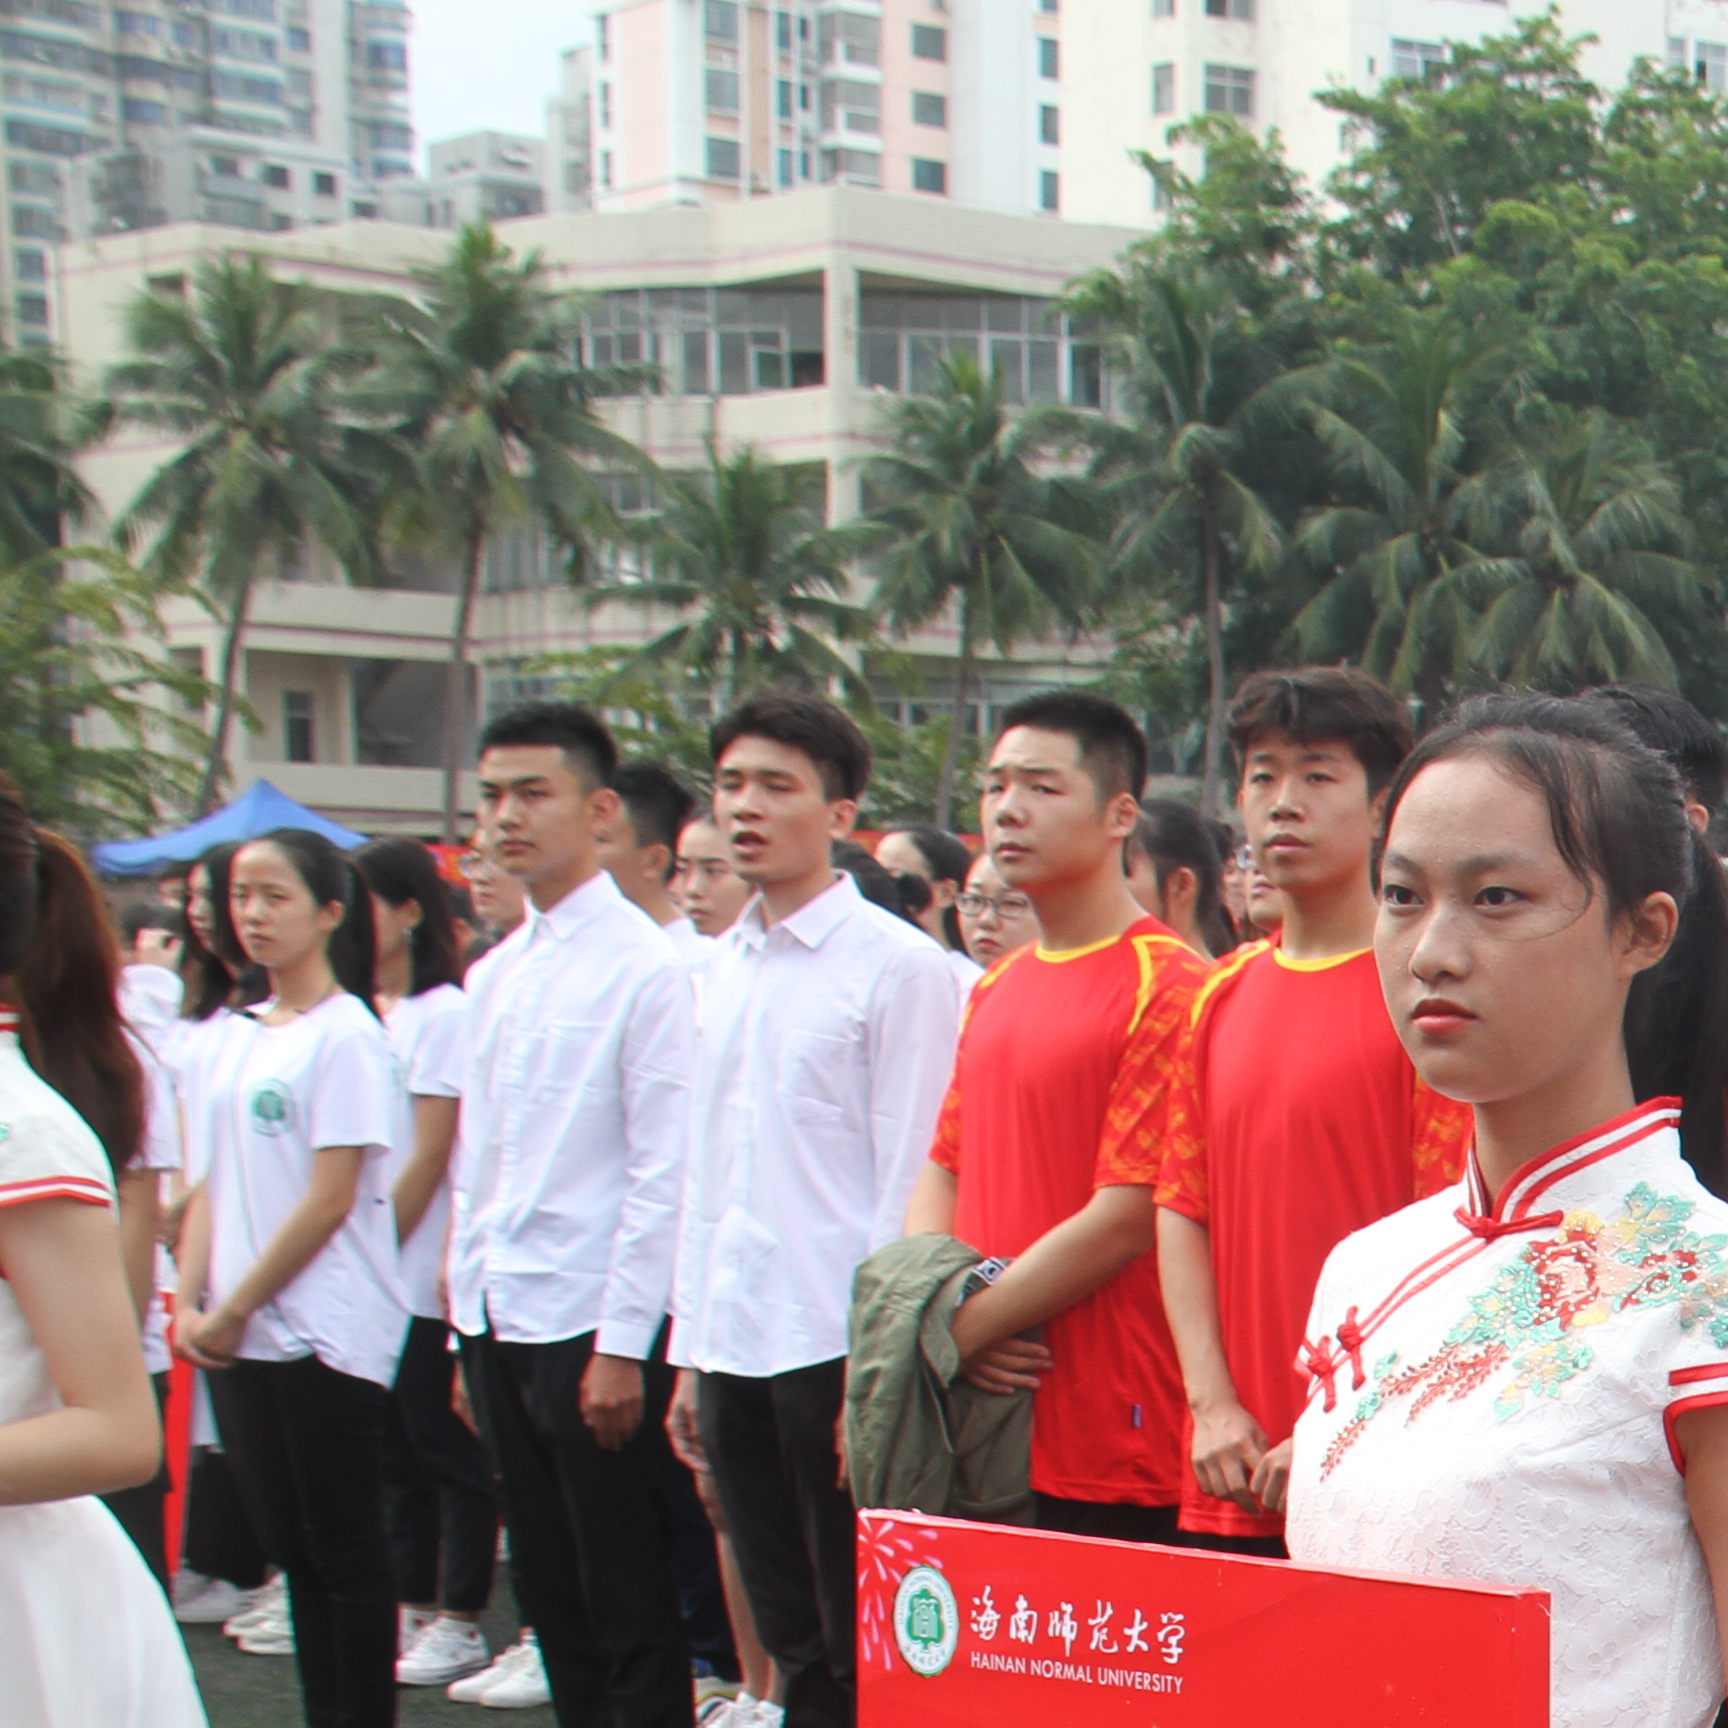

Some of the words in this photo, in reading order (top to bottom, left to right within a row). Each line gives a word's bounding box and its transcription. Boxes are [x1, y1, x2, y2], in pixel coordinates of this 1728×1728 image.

[969, 1585, 1186, 1665] 海南师范大学
[970, 1650, 1026, 1675] HAINAN
[1030, 1659, 1093, 1684] NORMAL
[1097, 1666, 1184, 1695] UNIVERSITY
